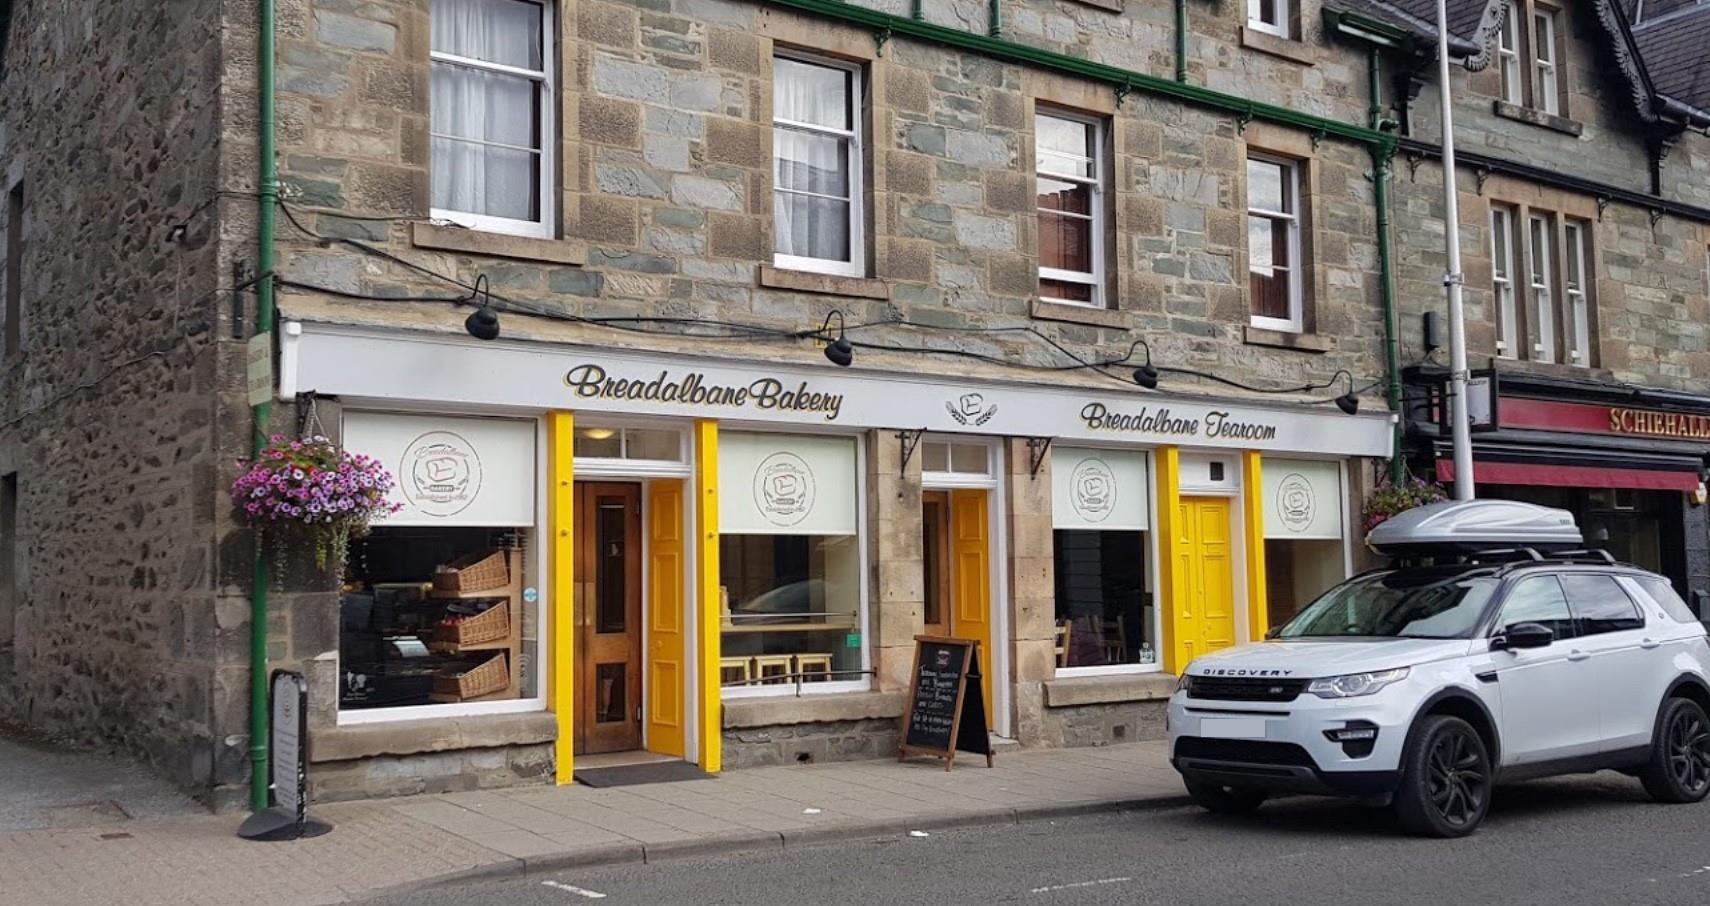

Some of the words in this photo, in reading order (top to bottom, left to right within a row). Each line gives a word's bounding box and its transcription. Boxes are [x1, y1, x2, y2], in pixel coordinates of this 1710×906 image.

[564, 363, 746, 407] Breadalbane
[748, 377, 844, 421] Bakery
[1081, 402, 1199, 434] Breadalbane
[1204, 410, 1276, 440] Tearoom
[1610, 407, 1710, 437] SCHIEHALL
